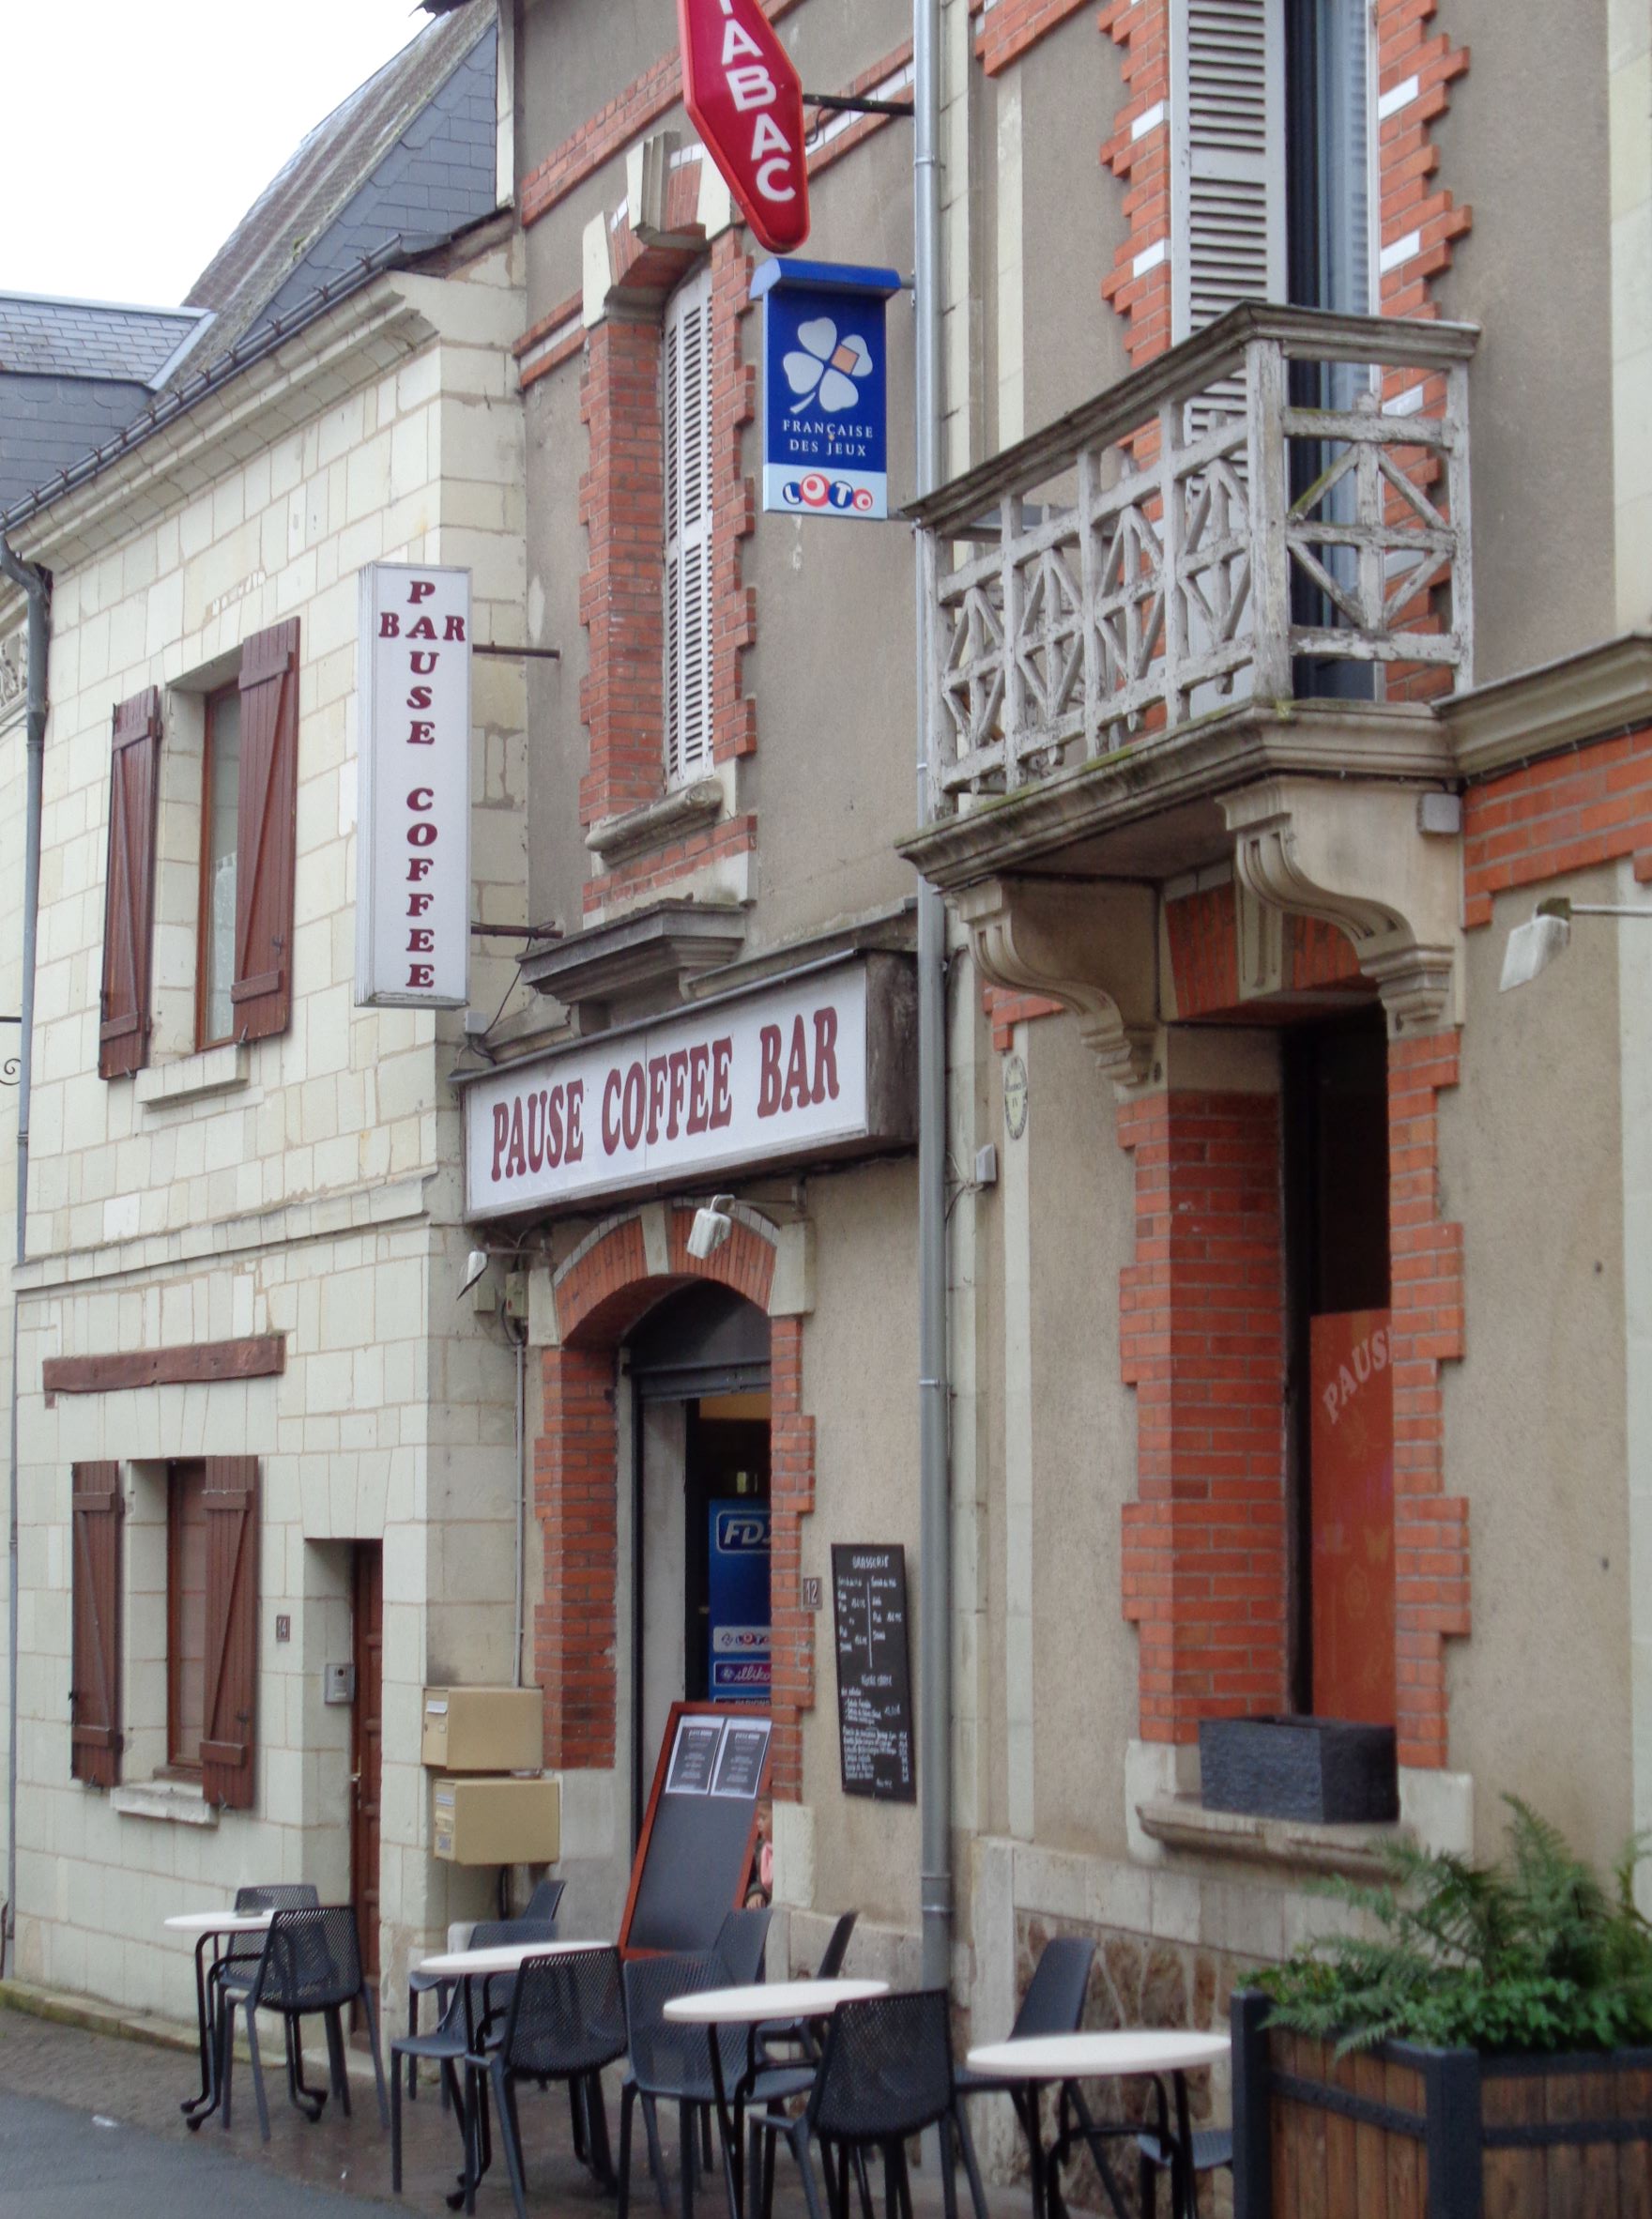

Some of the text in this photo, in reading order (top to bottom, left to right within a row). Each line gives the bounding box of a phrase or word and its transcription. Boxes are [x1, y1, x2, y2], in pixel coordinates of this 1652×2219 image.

[789, 437, 866, 457] DES JEUX
[782, 472, 873, 512] LOTO
[378, 611, 466, 642] BAR
[405, 580, 440, 745] PAUSE
[405, 787, 438, 988] COFFEE
[490, 1005, 840, 1183] PAUSE COFFEE BAR
[1322, 1325, 1392, 1426] PAUS
[724, 1520, 771, 1545] FD
[805, 1579, 818, 1604] 12
